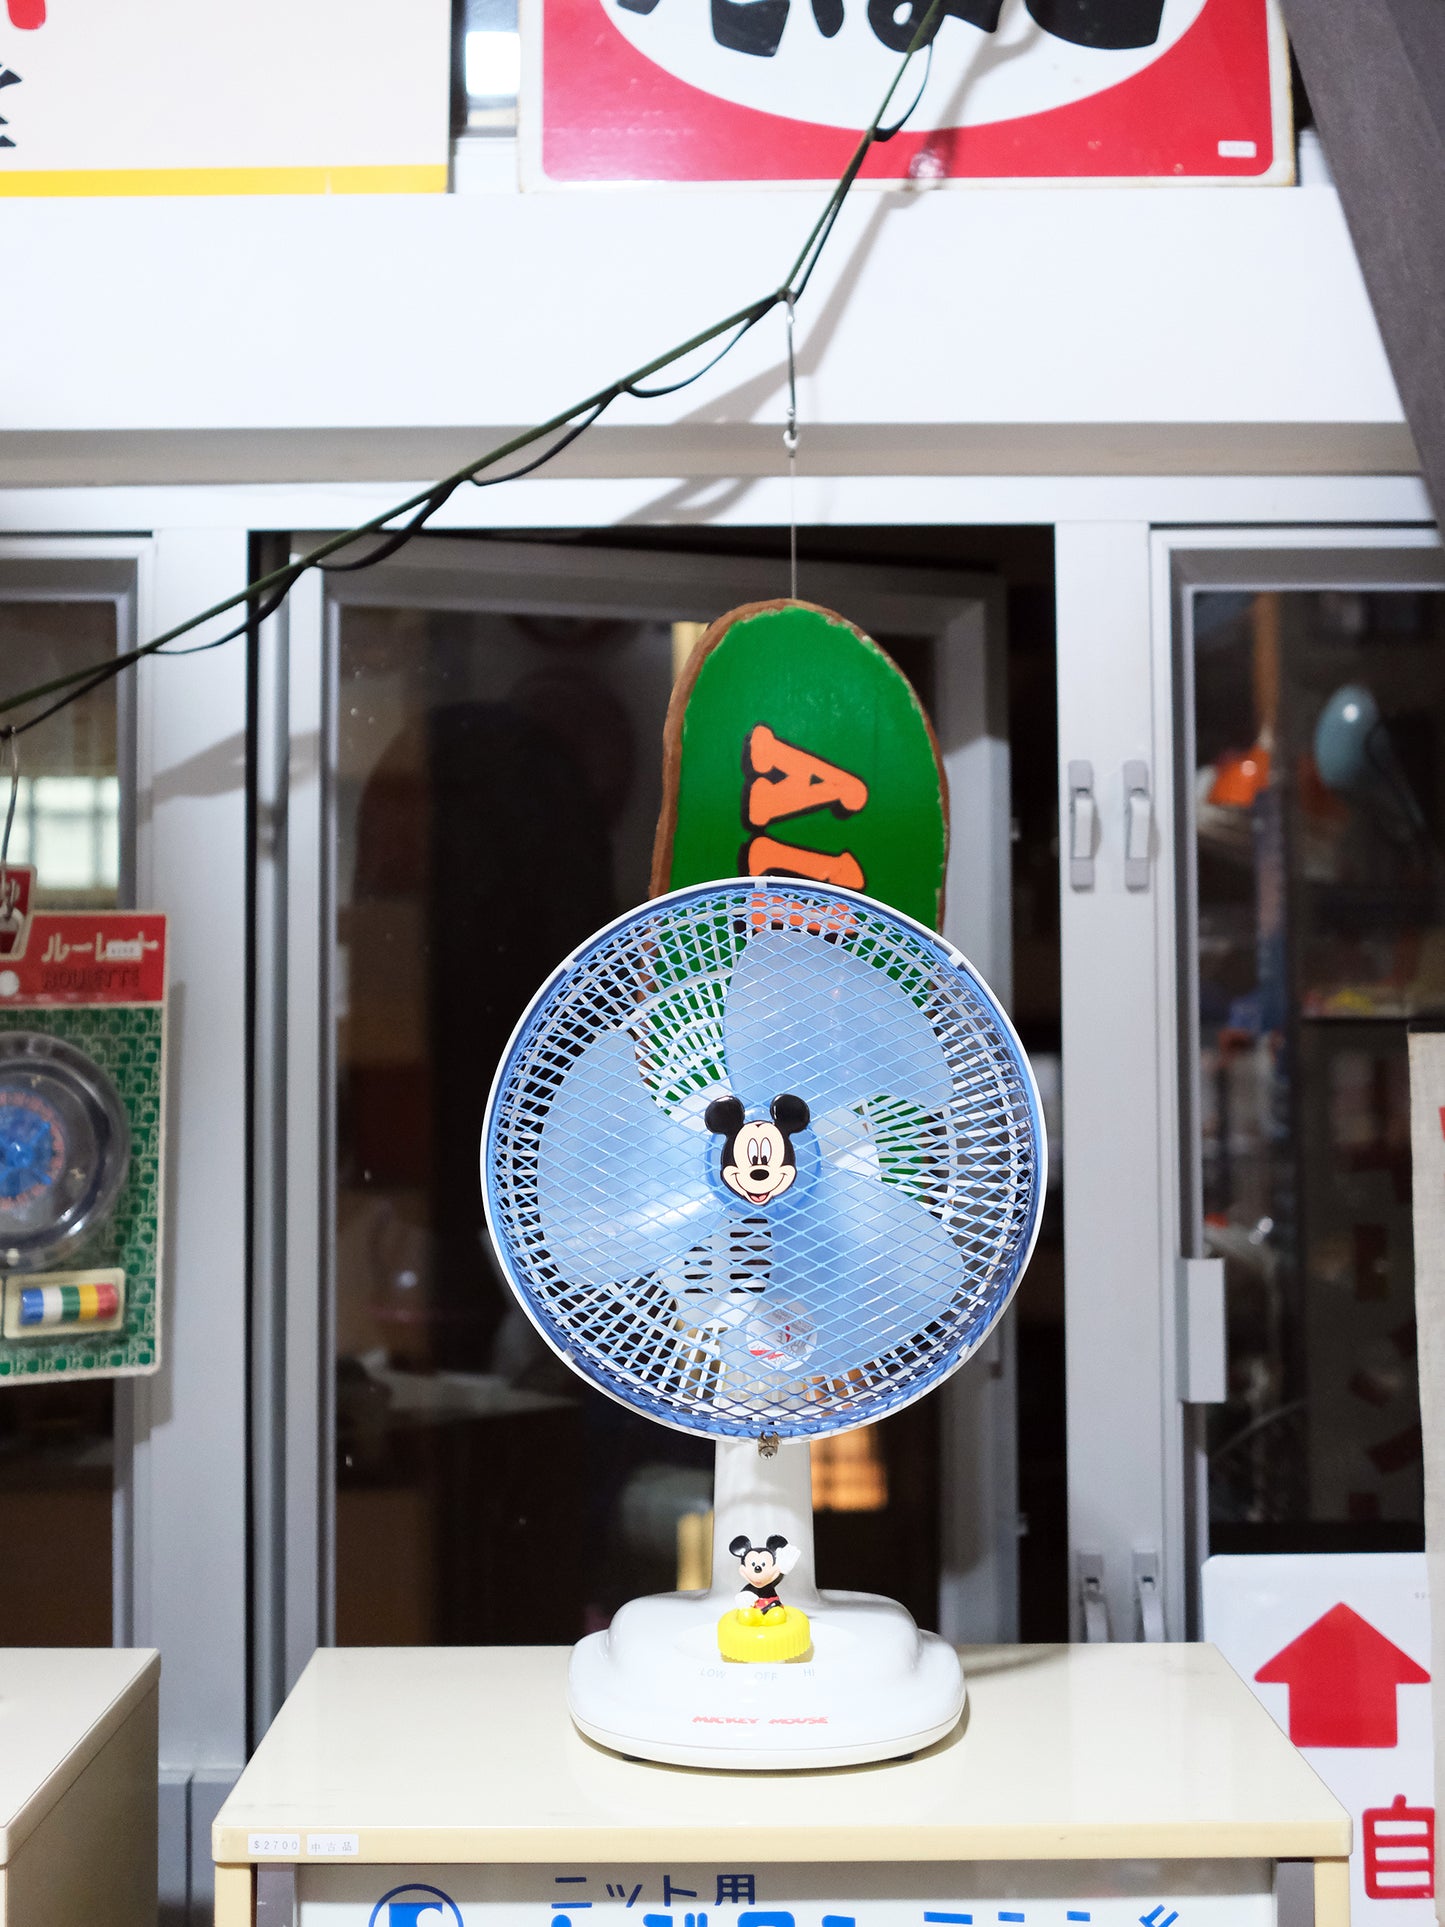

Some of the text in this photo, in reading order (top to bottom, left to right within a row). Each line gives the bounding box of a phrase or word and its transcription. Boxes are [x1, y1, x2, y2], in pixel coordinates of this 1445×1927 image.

[700, 1667, 815, 1681] LOW OFF HI
[692, 1716, 829, 1724] MICKEY MOUSE
[311, 1841, 352, 1853] 中古品
[1362, 1793, 1435, 1899] 自
[551, 1873, 756, 1909] ニット用
